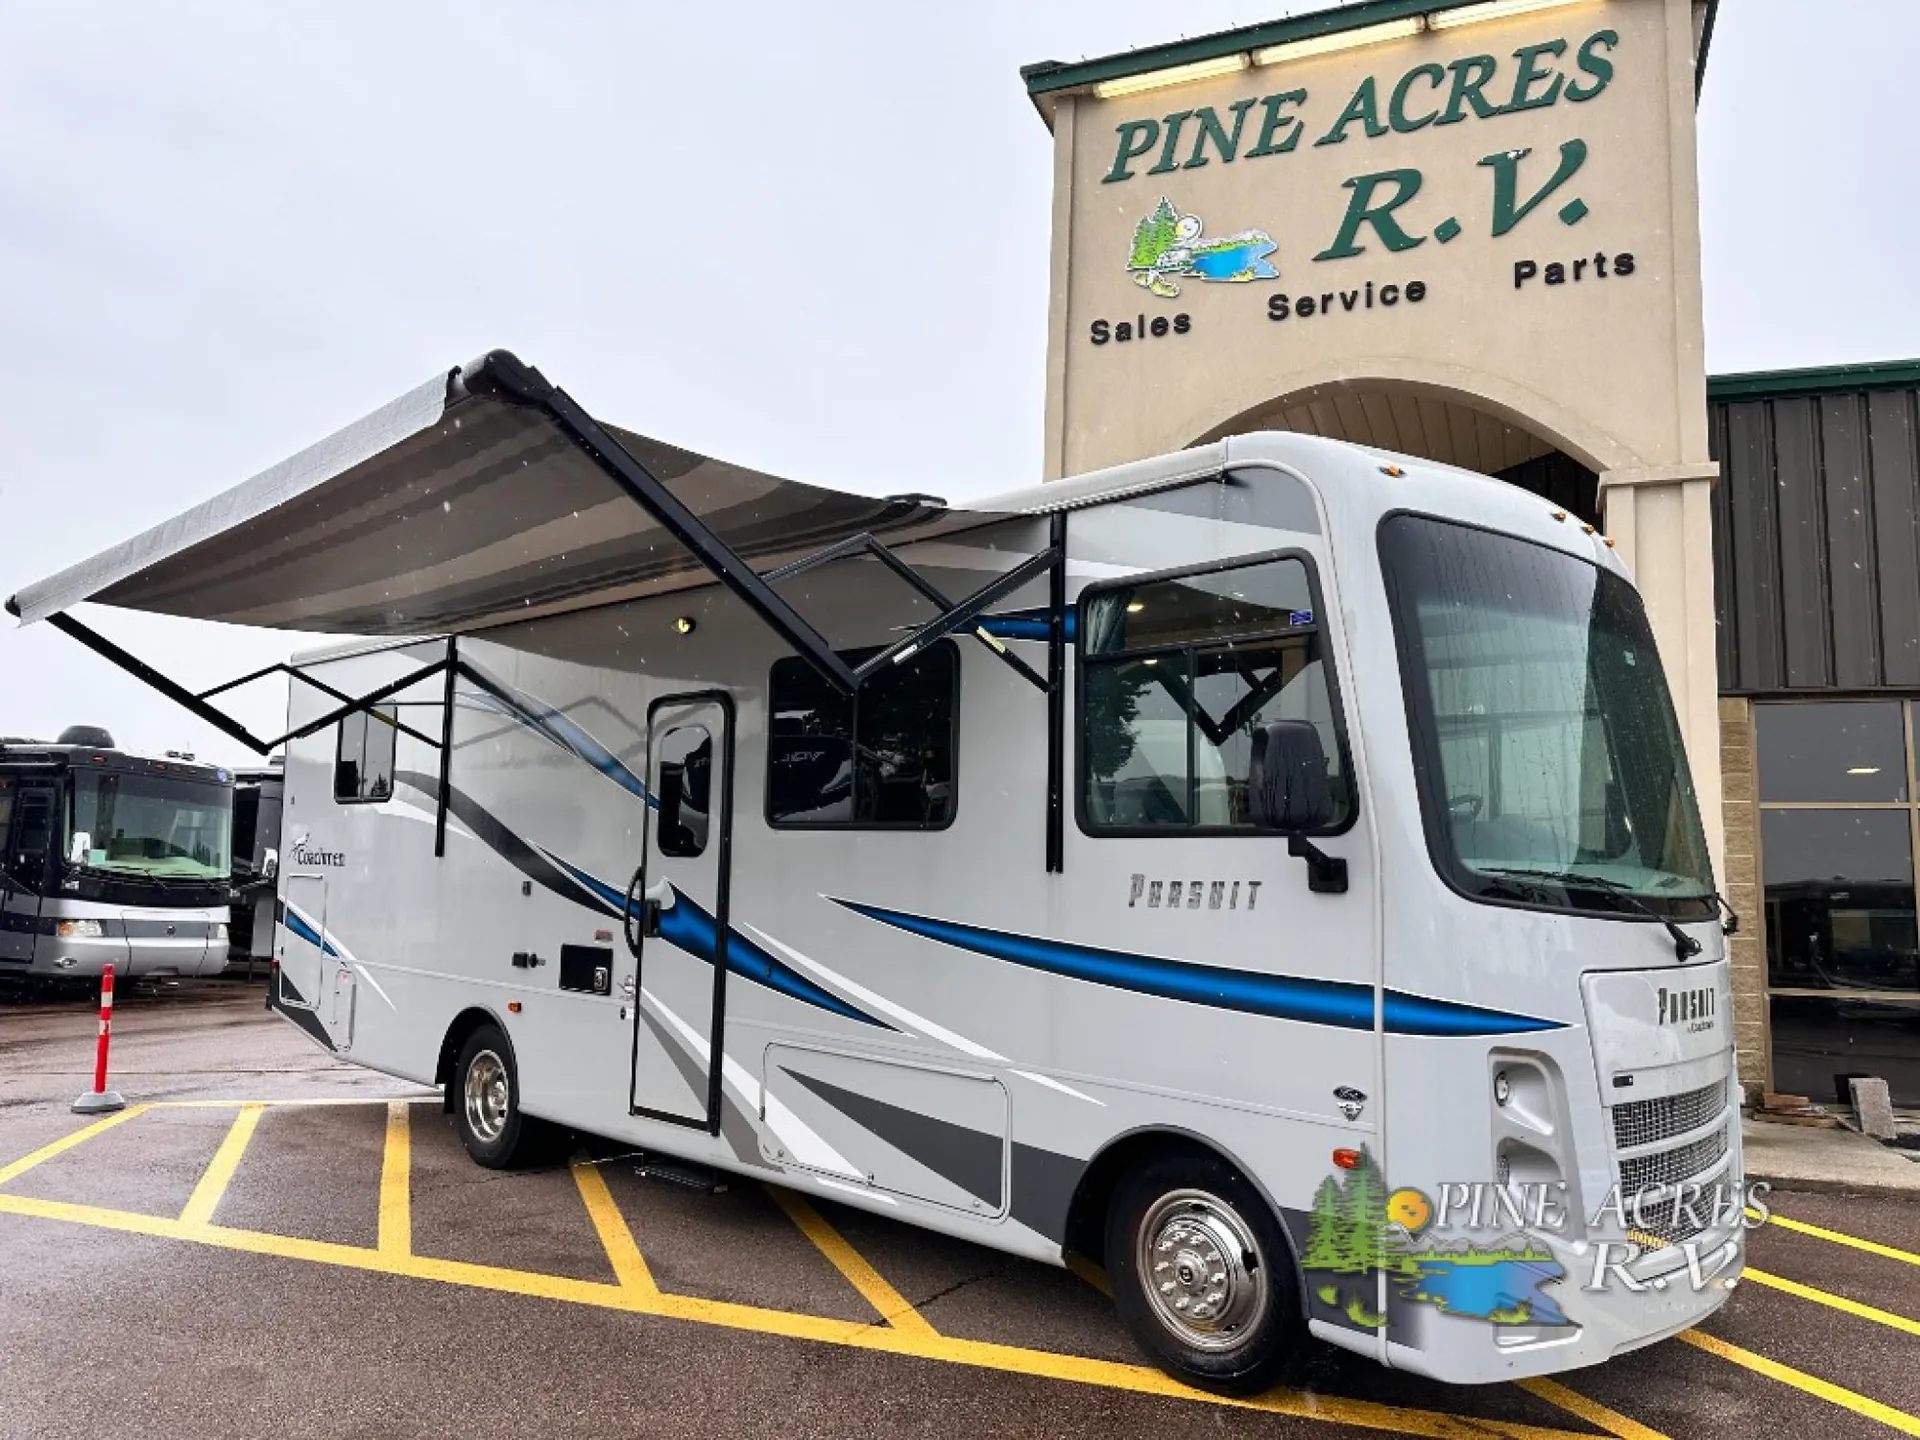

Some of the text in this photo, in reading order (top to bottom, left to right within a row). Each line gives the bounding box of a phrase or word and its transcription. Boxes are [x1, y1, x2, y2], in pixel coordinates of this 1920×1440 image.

[1101, 28, 1620, 185] PINE ACRES
[1312, 138, 1589, 262] R.V.
[1090, 251, 1636, 345] Sales Service Parts
